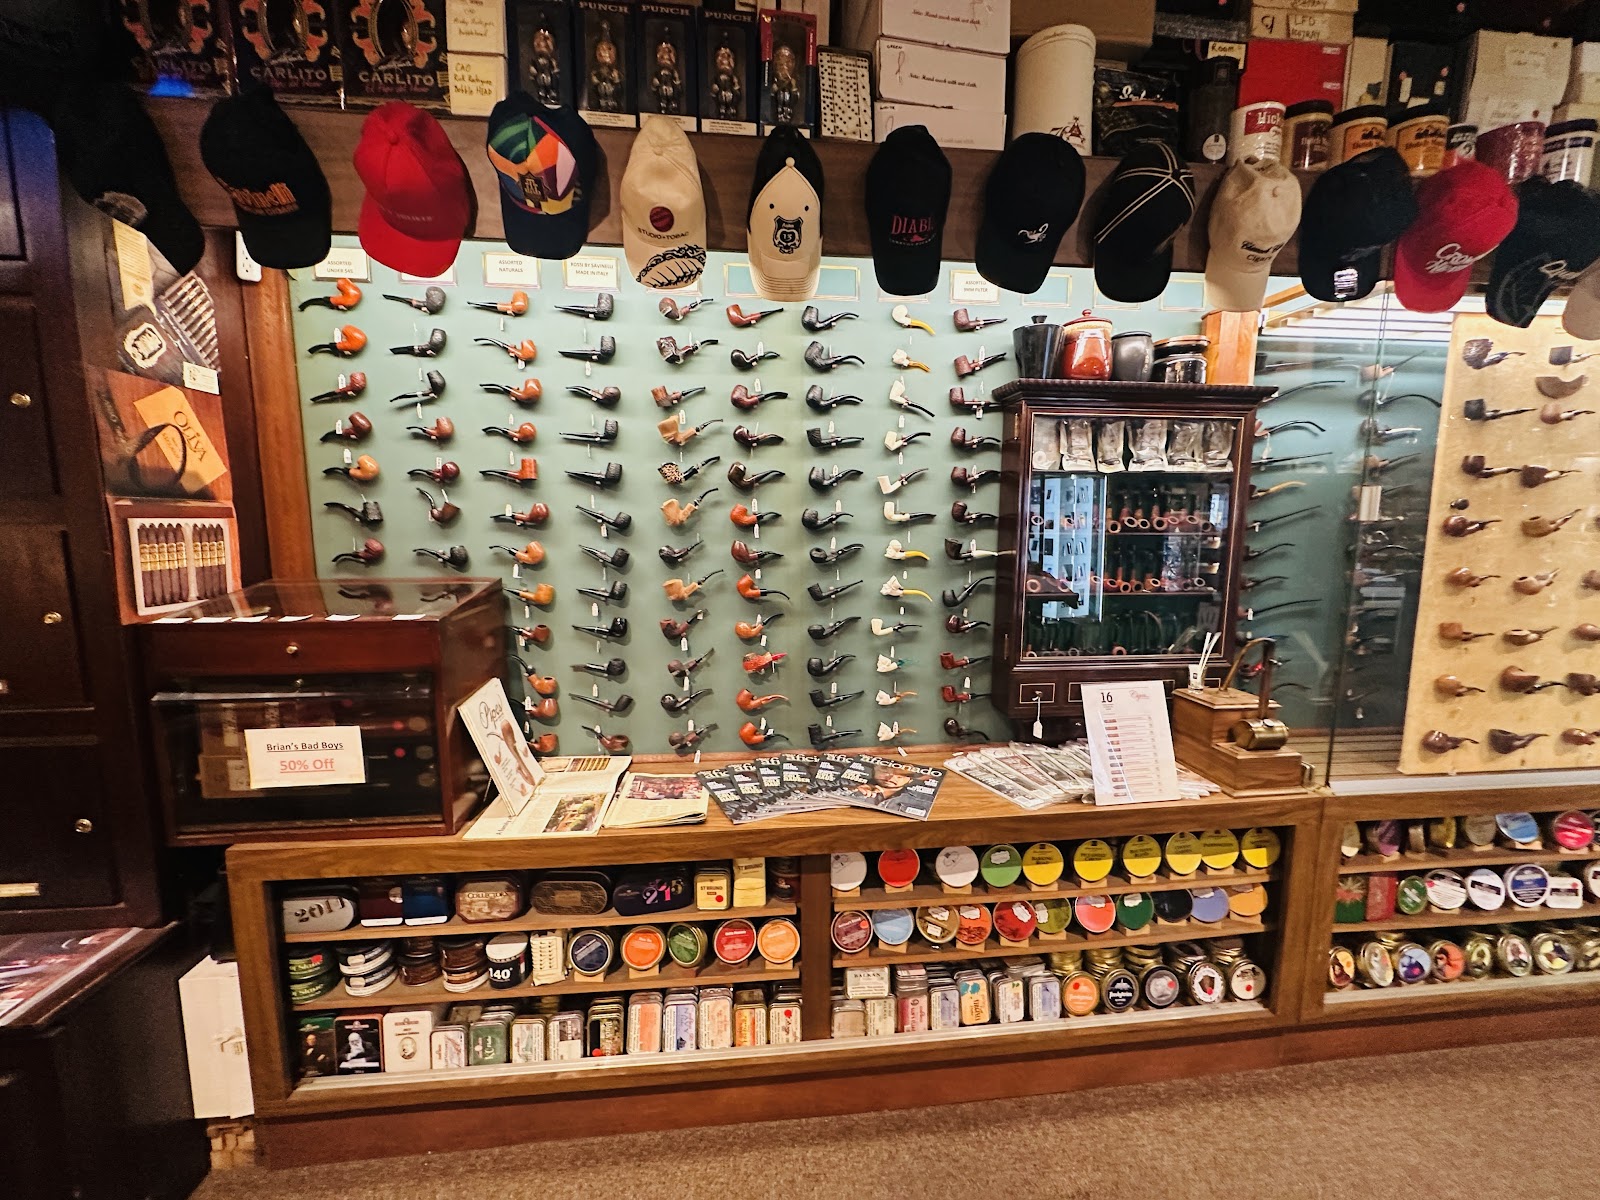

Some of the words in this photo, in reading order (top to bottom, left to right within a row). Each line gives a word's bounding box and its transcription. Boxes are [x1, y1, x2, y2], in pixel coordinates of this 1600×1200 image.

[579, 1, 629, 13] PUNCH
[641, 5, 690, 16] PUNCH
[705, 11, 752, 22] PUNCH
[250, 66, 327, 81] CARLITO
[359, 72, 434, 86] CARLITO
[638, 227, 662, 240] STUDIO
[666, 231, 690, 240] TOBAC
[174, 411, 207, 462] OLIVA
[1100, 692, 1113, 703] 16
[266, 742, 299, 751] Brian's
[301, 742, 319, 750] Bad
[321, 741, 344, 750] Boys
[280, 760, 309, 771] 50%
[313, 758, 335, 769] Off
[861, 754, 943, 777] aficionado
